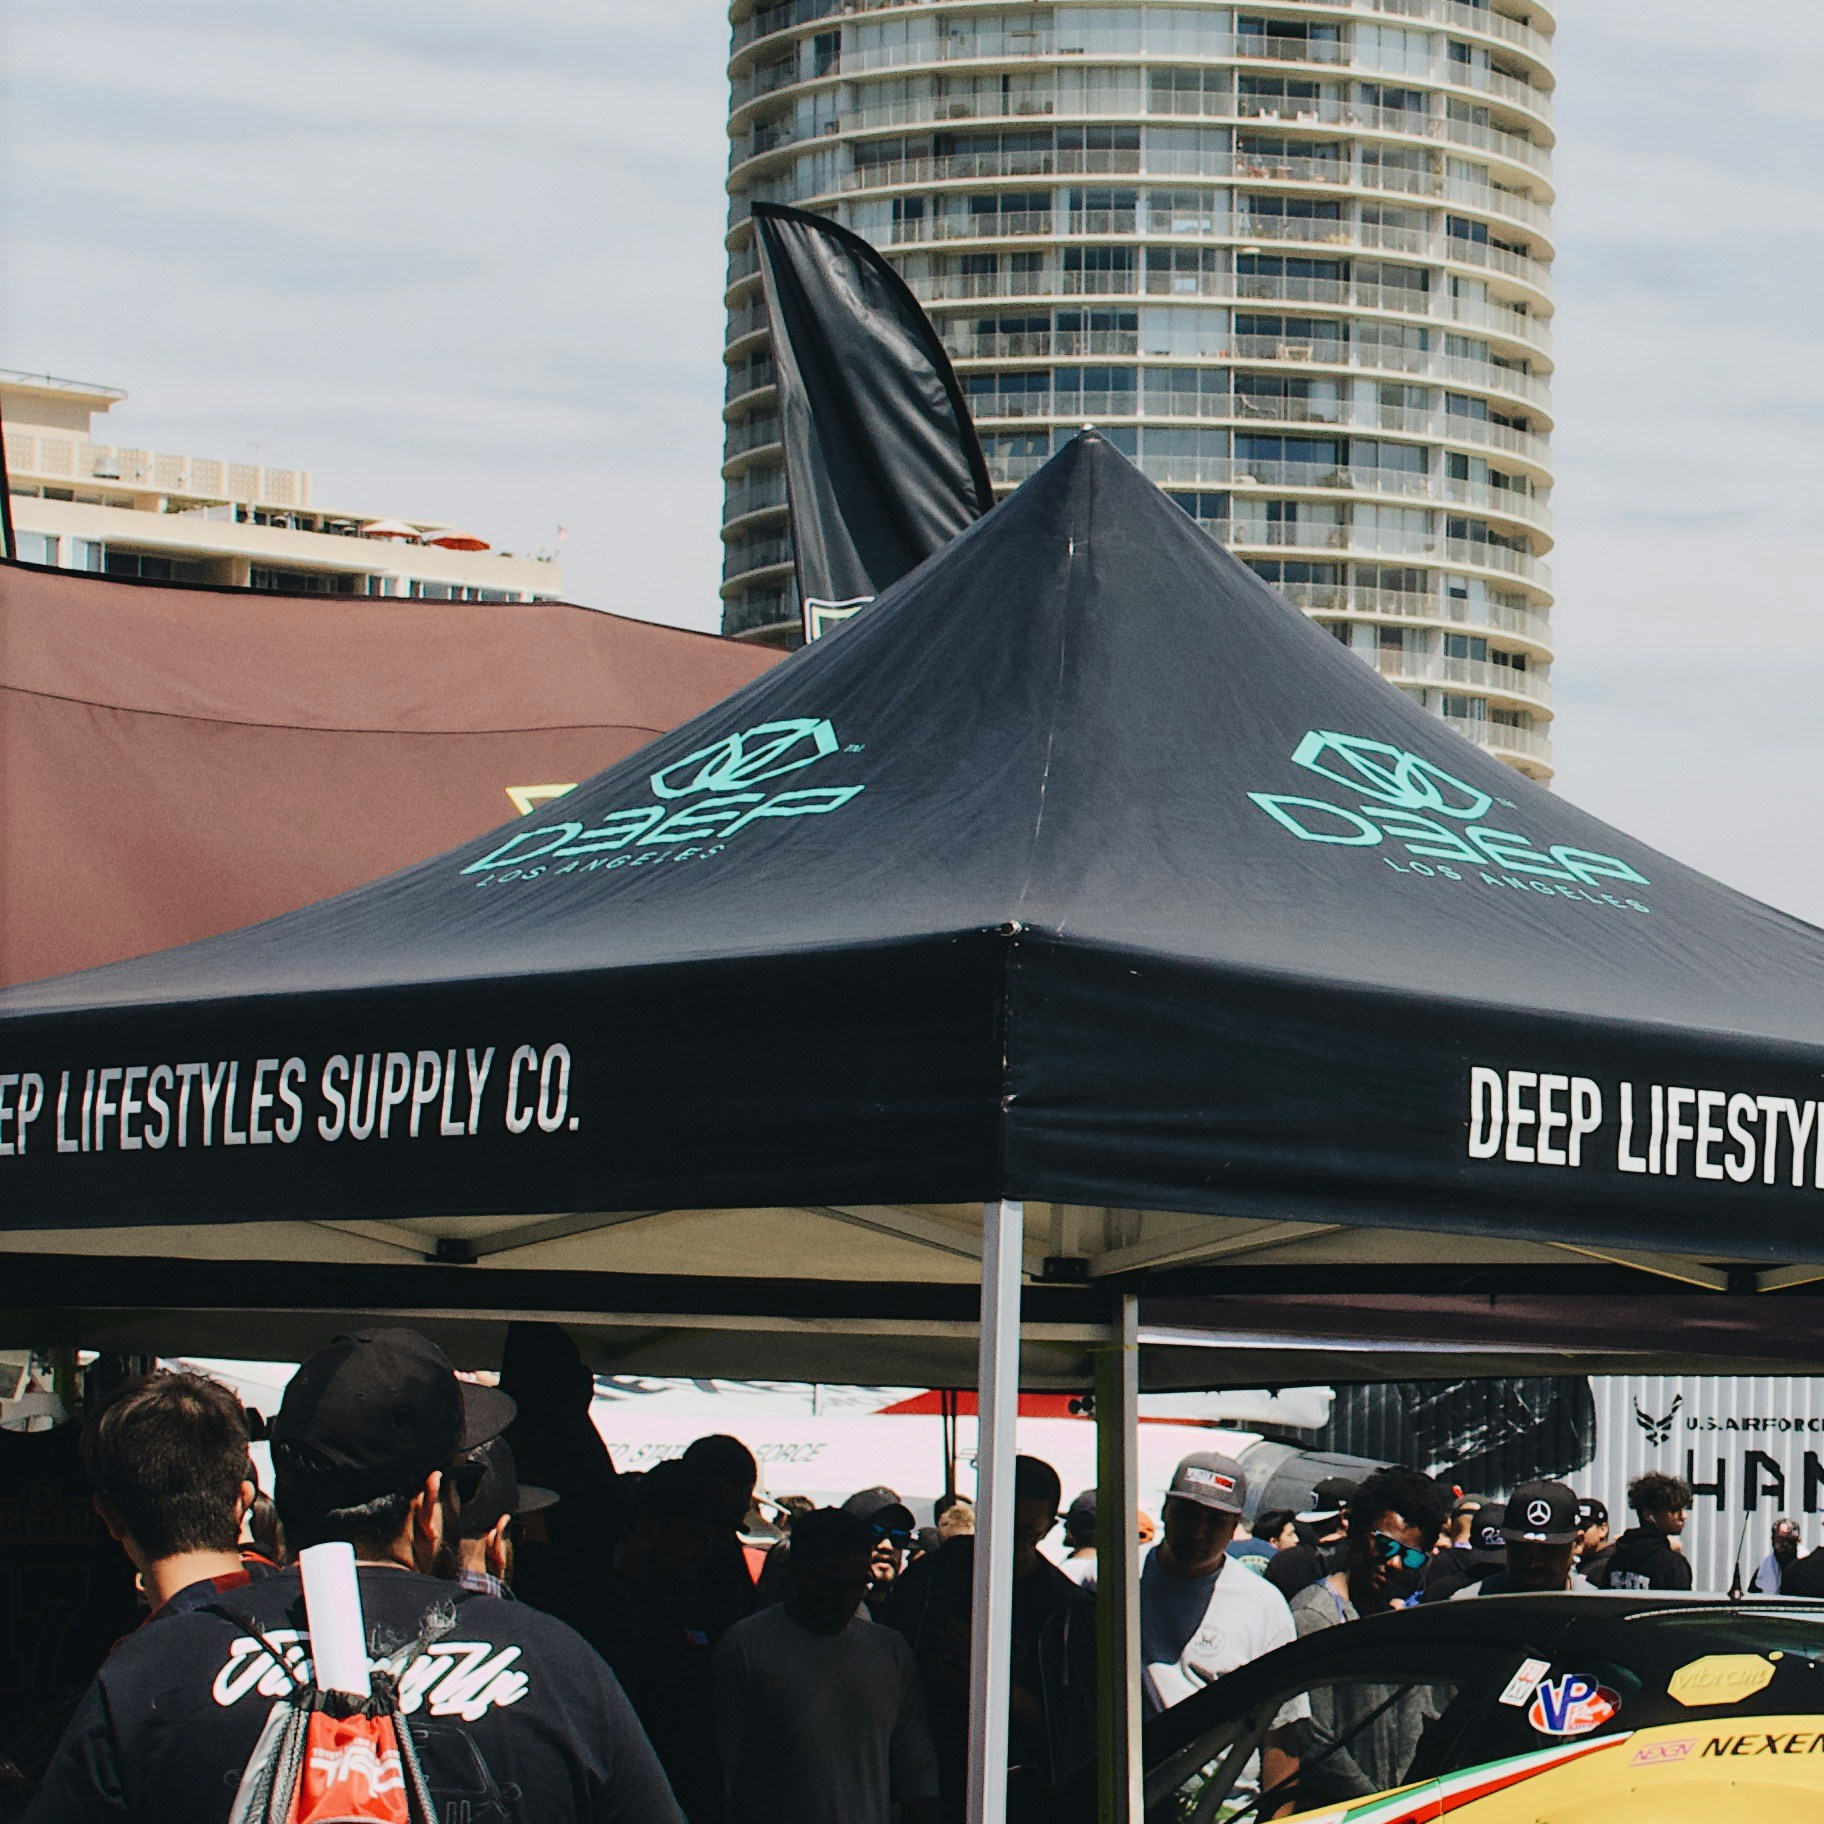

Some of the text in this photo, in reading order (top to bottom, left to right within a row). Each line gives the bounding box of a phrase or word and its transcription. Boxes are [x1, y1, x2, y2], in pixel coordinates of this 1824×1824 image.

[475, 842, 726, 888] LOS ANGELES
[1382, 856, 1651, 915] LOS ANGELES
[57, 1056, 307, 1154] LIFESTYLES
[317, 1046, 496, 1142] SUPPLY
[504, 1042, 580, 1135] CO.
[1467, 1065, 1603, 1168] DEEP
[1539, 1674, 1600, 1732] VP
